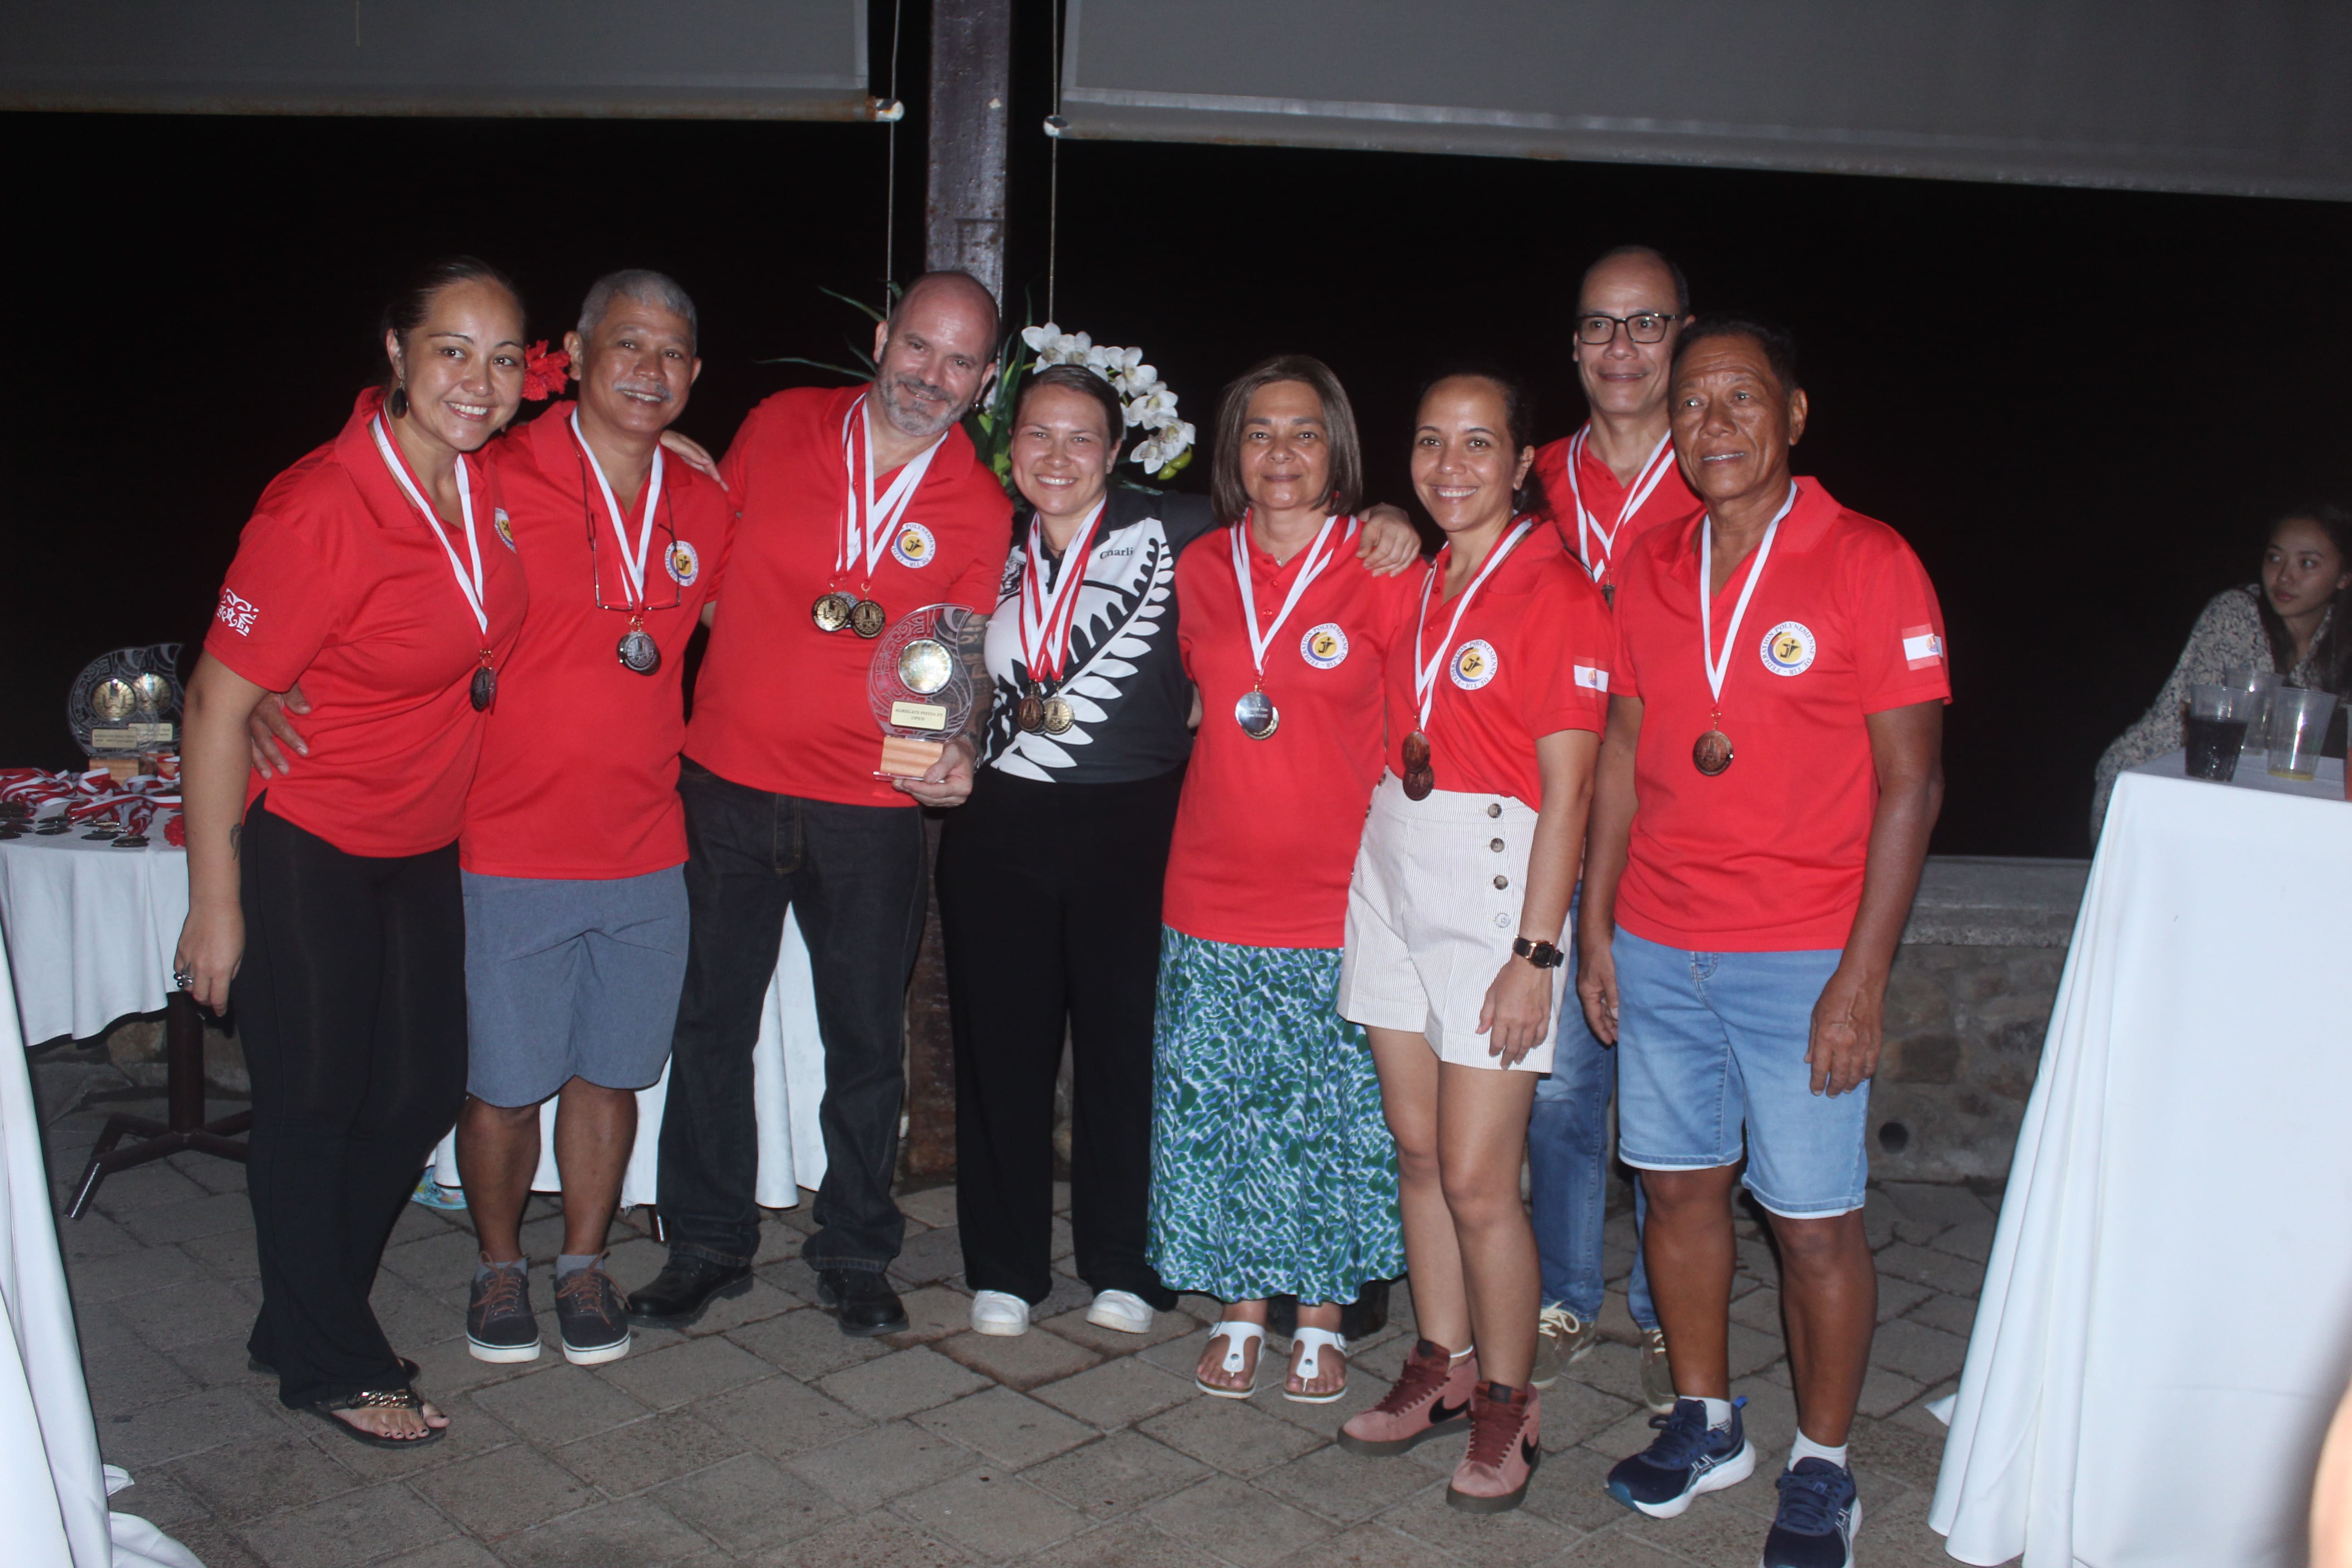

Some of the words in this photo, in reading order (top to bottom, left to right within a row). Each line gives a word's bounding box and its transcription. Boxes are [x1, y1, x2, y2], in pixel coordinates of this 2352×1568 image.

[1302, 632, 1319, 666] FEDERATION
[1313, 624, 1348, 650] POLYNESIENNE
[1338, 652, 1346, 662] DE
[1451, 645, 1468, 685] FEDERATION
[1470, 641, 1497, 676] POLYNESIENNE
[1762, 632, 1781, 673] FEDERATION
[1775, 622, 1815, 656] POLYNESIENNE
[1803, 657, 1813, 669] DE
[1479, 676, 1489, 686] DE
